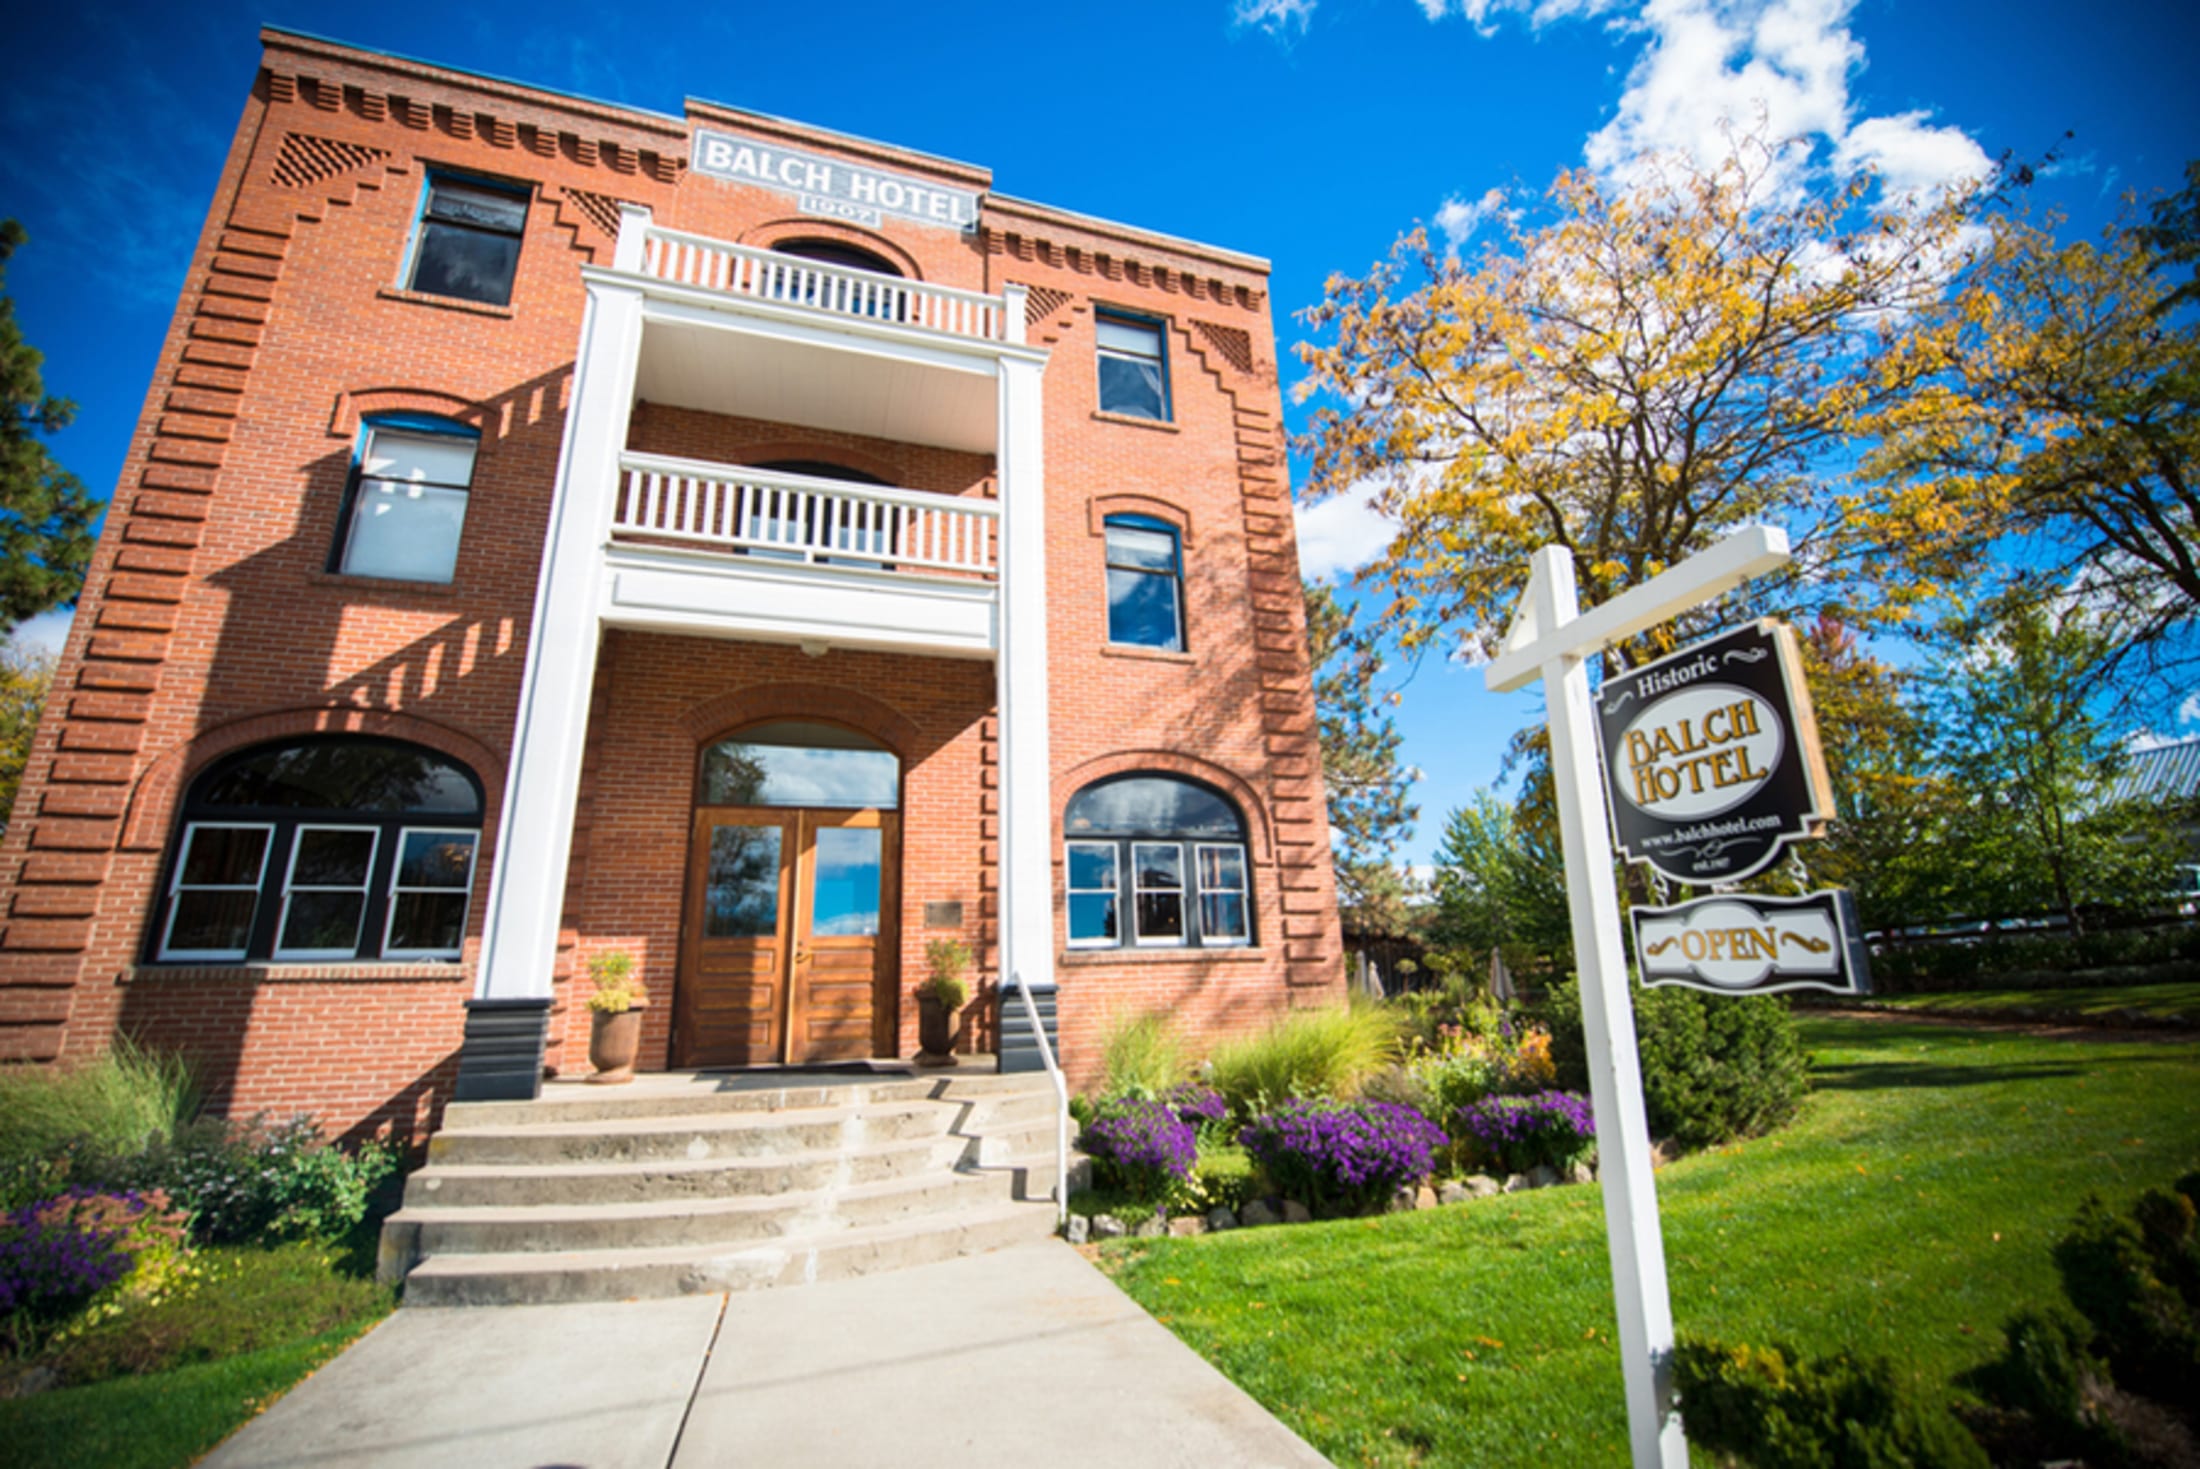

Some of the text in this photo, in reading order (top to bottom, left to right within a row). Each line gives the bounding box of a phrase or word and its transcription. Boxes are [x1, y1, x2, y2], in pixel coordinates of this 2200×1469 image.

[704, 139, 973, 224] BALCH HOTEL
[810, 199, 872, 222] 1907
[1636, 653, 1718, 699] Historic
[1624, 698, 1761, 769] BALCH
[1632, 745, 1768, 806] HOTEL
[1641, 814, 1782, 848] www.balchhotel.com
[1680, 926, 1779, 961] OPEN
